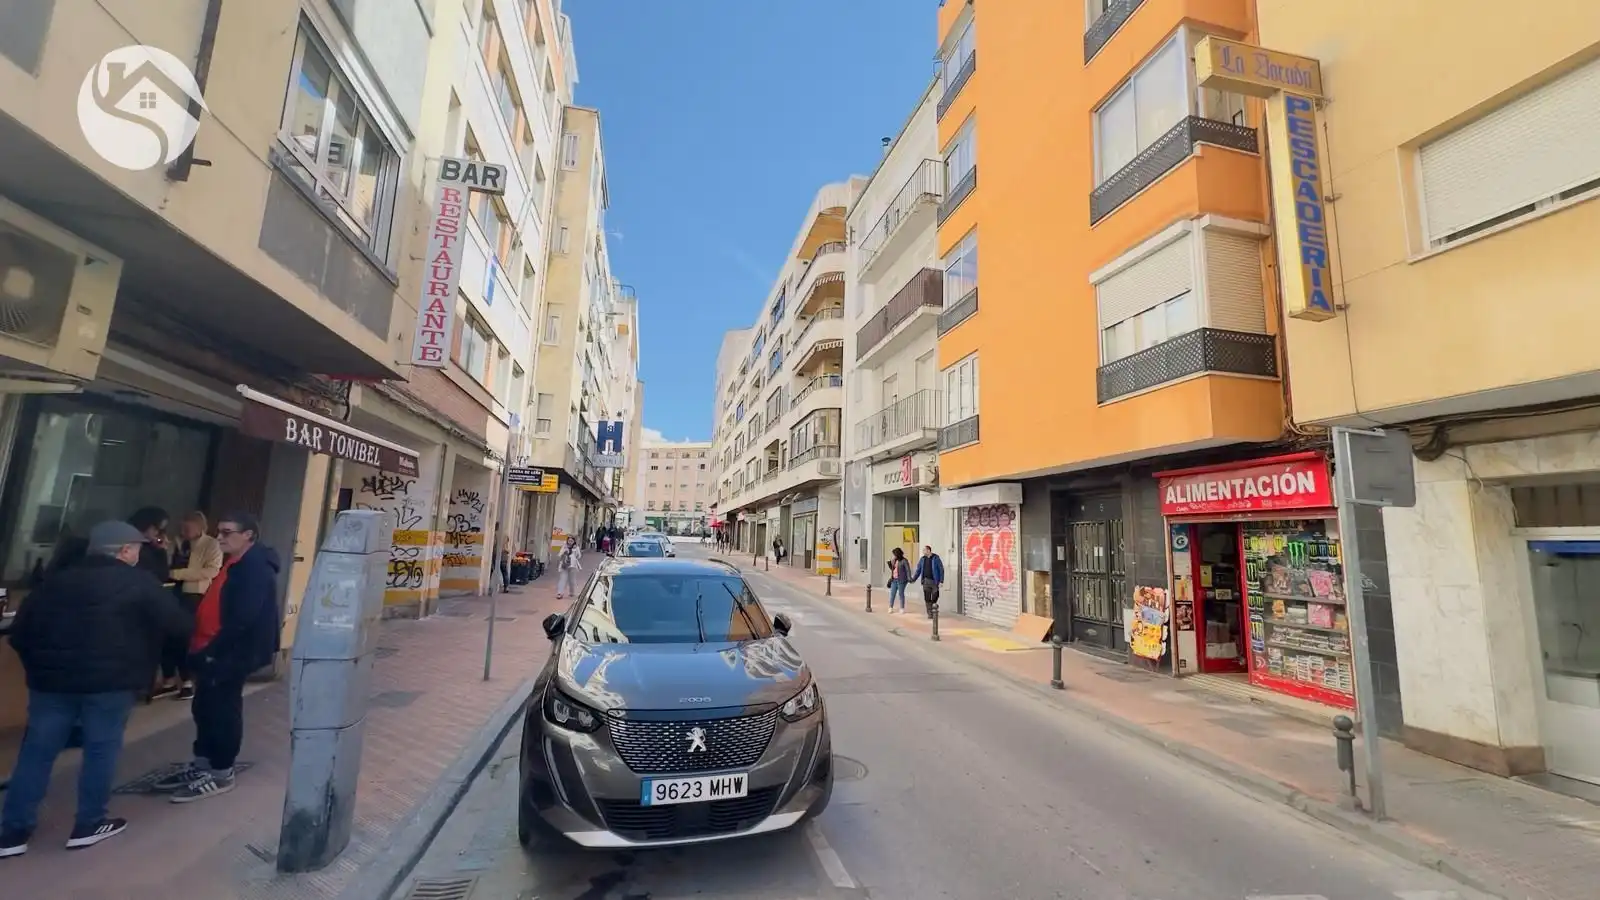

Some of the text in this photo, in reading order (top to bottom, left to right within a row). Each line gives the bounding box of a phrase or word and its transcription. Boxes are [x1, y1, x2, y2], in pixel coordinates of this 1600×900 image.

[440, 159, 501, 189] BAR
[1286, 95, 1331, 312] PESCADERIA
[419, 186, 462, 363] RESTAURANTE
[285, 418, 322, 450] BAR
[329, 431, 380, 466] TONIBEL
[1165, 466, 1316, 505] ALIMENTACIÓN
[656, 777, 743, 801] 9623 MHW
